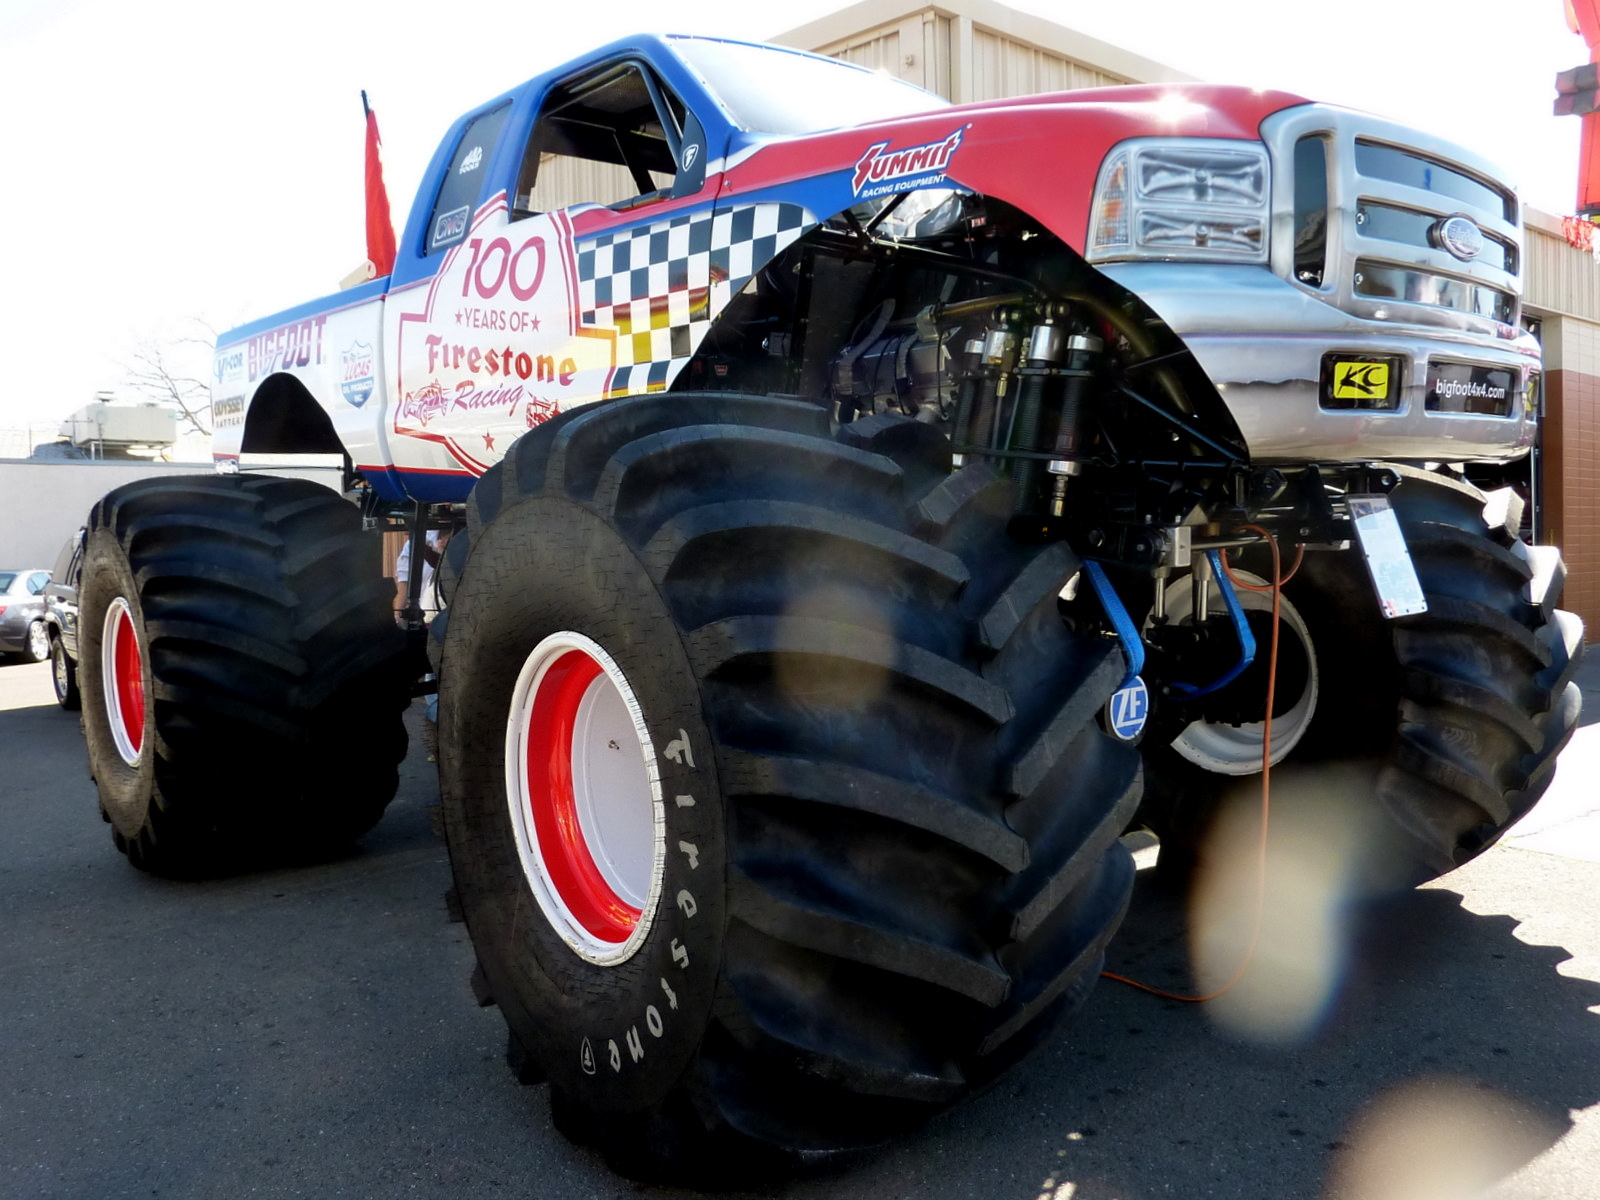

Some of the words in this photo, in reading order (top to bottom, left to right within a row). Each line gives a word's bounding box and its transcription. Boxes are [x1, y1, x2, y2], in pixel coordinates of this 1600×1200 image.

[861, 183, 893, 198] RACING
[894, 173, 947, 192] EQUIPMENT
[462, 236, 546, 301] 100
[465, 308, 506, 331] YEARS
[509, 311, 530, 333] OF
[248, 315, 327, 382] BIGFOOT
[425, 334, 578, 387] Firestone
[451, 380, 524, 417] Racing
[1337, 364, 1386, 395] KC
[1435, 378, 1505, 399] bigfoot4x4.com
[1113, 686, 1146, 728] ZF
[609, 728, 700, 1073] Firestone
